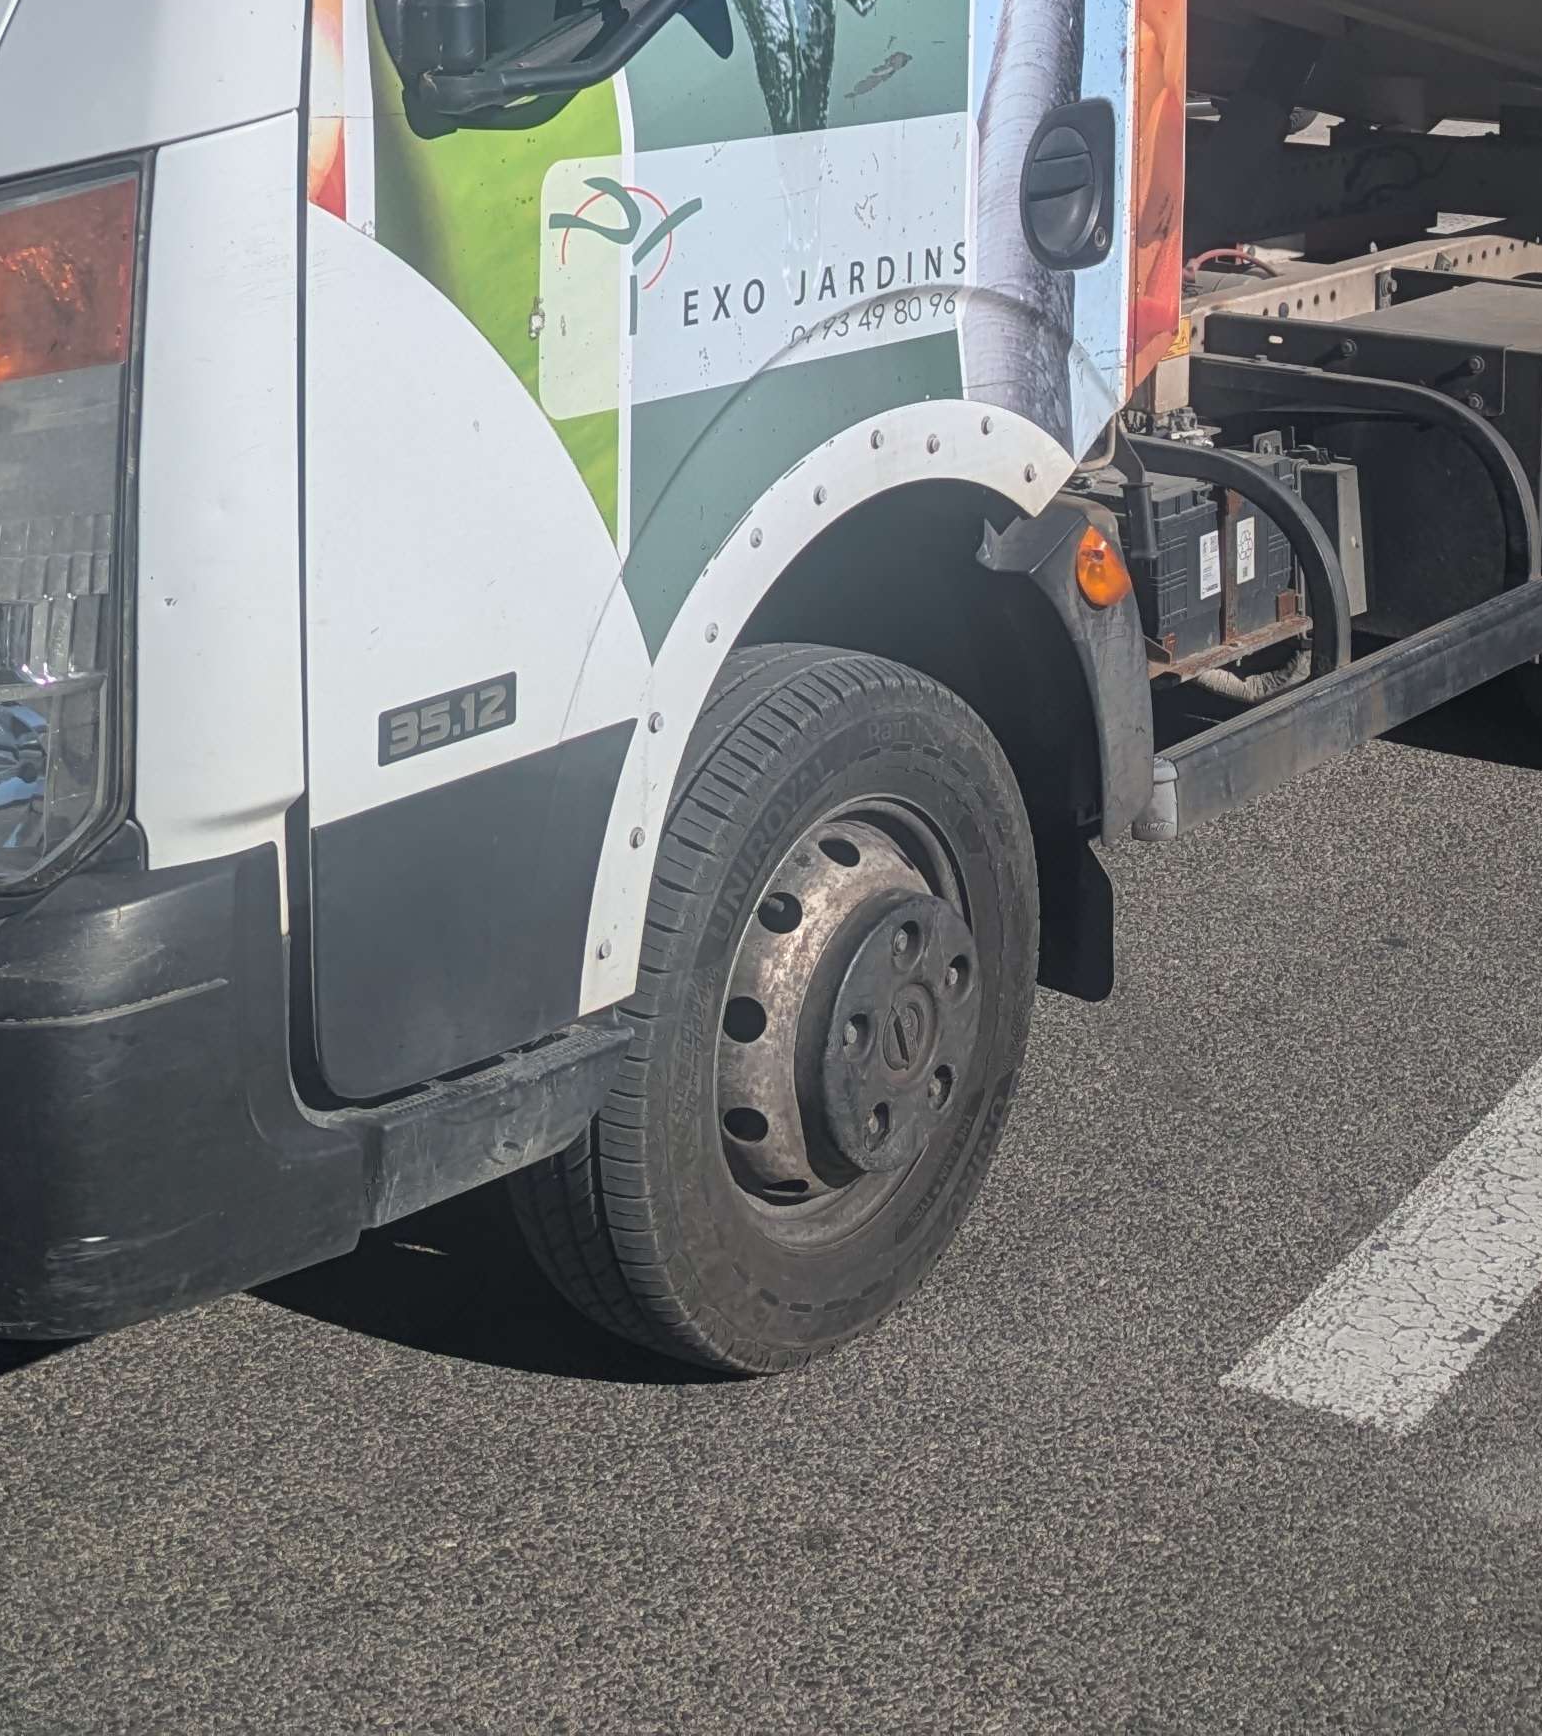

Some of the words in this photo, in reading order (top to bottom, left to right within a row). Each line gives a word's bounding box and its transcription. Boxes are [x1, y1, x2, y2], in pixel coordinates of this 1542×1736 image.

[683, 278, 765, 326] EXO
[794, 242, 966, 306] JARDINS
[858, 302, 886, 332] 49
[894, 294, 922, 325] 80
[929, 290, 957, 318] 96
[389, 684, 507, 756] 35.12
